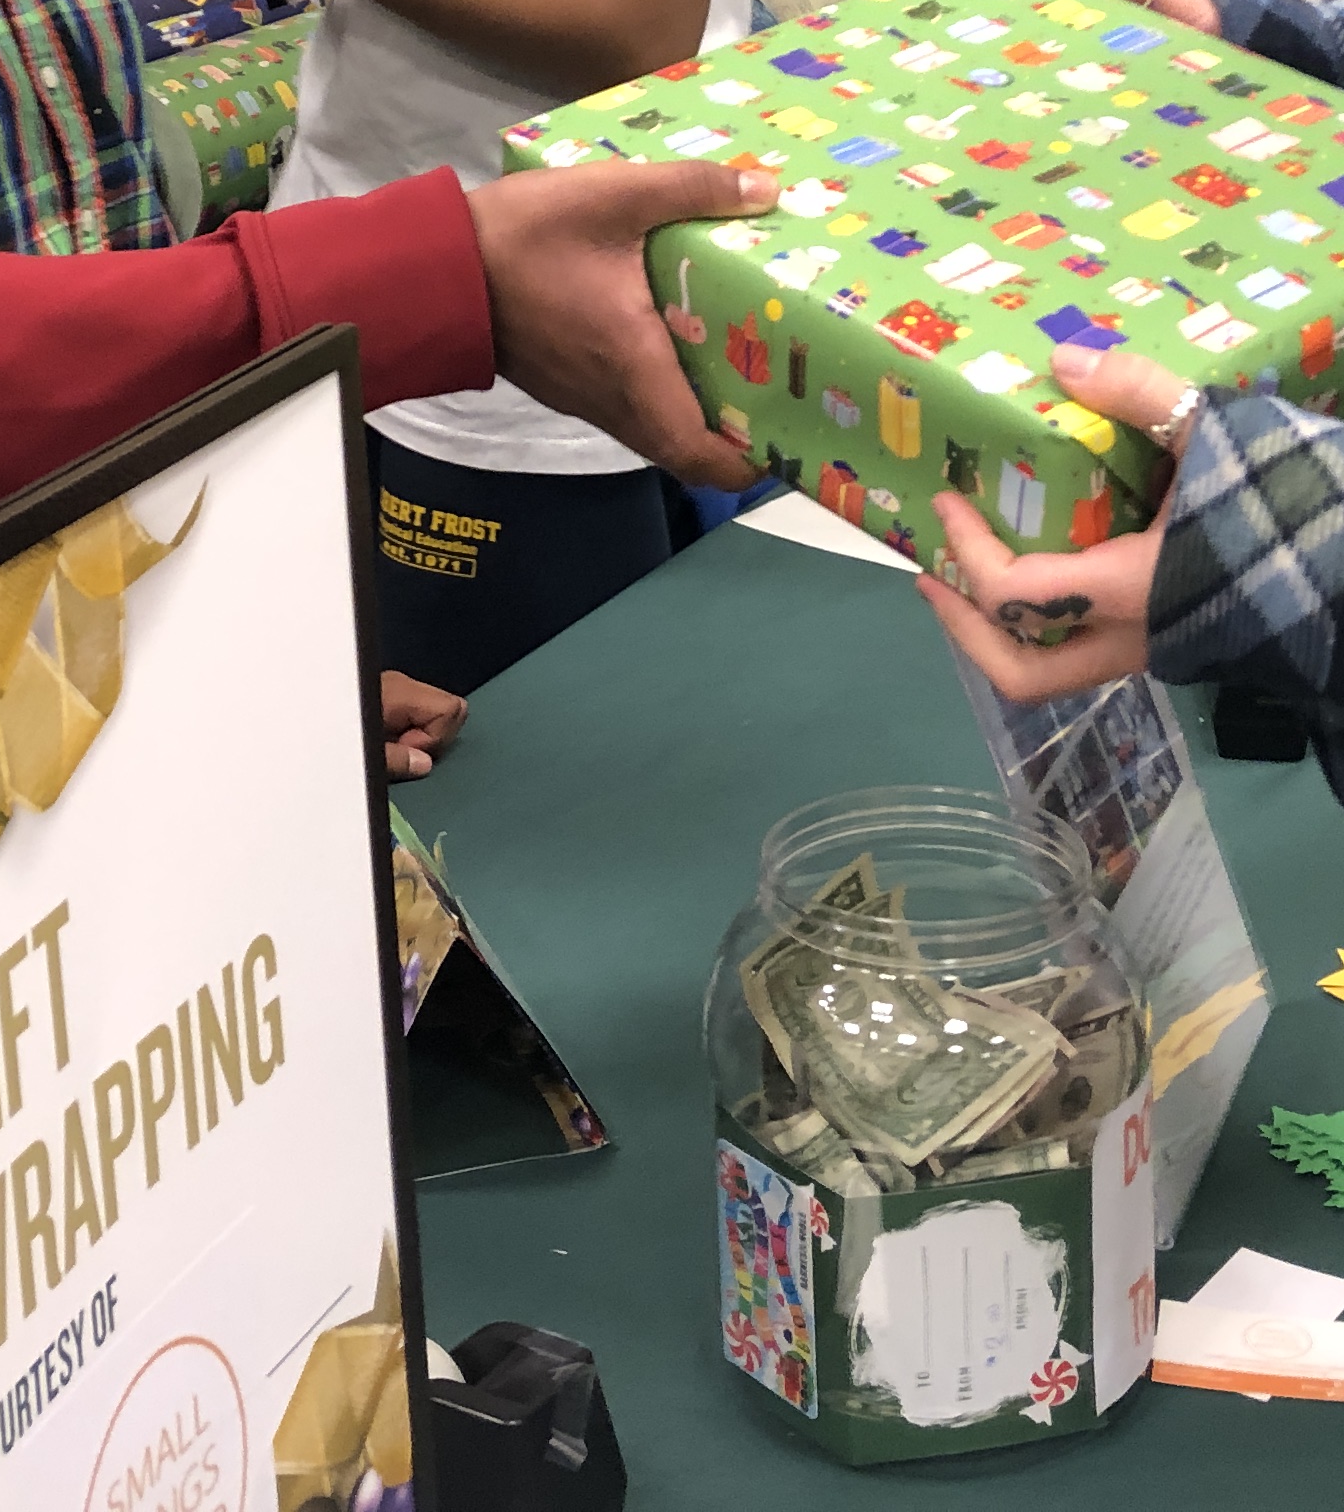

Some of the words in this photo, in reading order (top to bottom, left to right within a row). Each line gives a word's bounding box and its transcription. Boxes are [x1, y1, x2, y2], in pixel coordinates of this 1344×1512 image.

[430, 509, 502, 543] FROST
[90, 1274, 118, 1347] OF
[106, 1392, 212, 1512] SMALL
